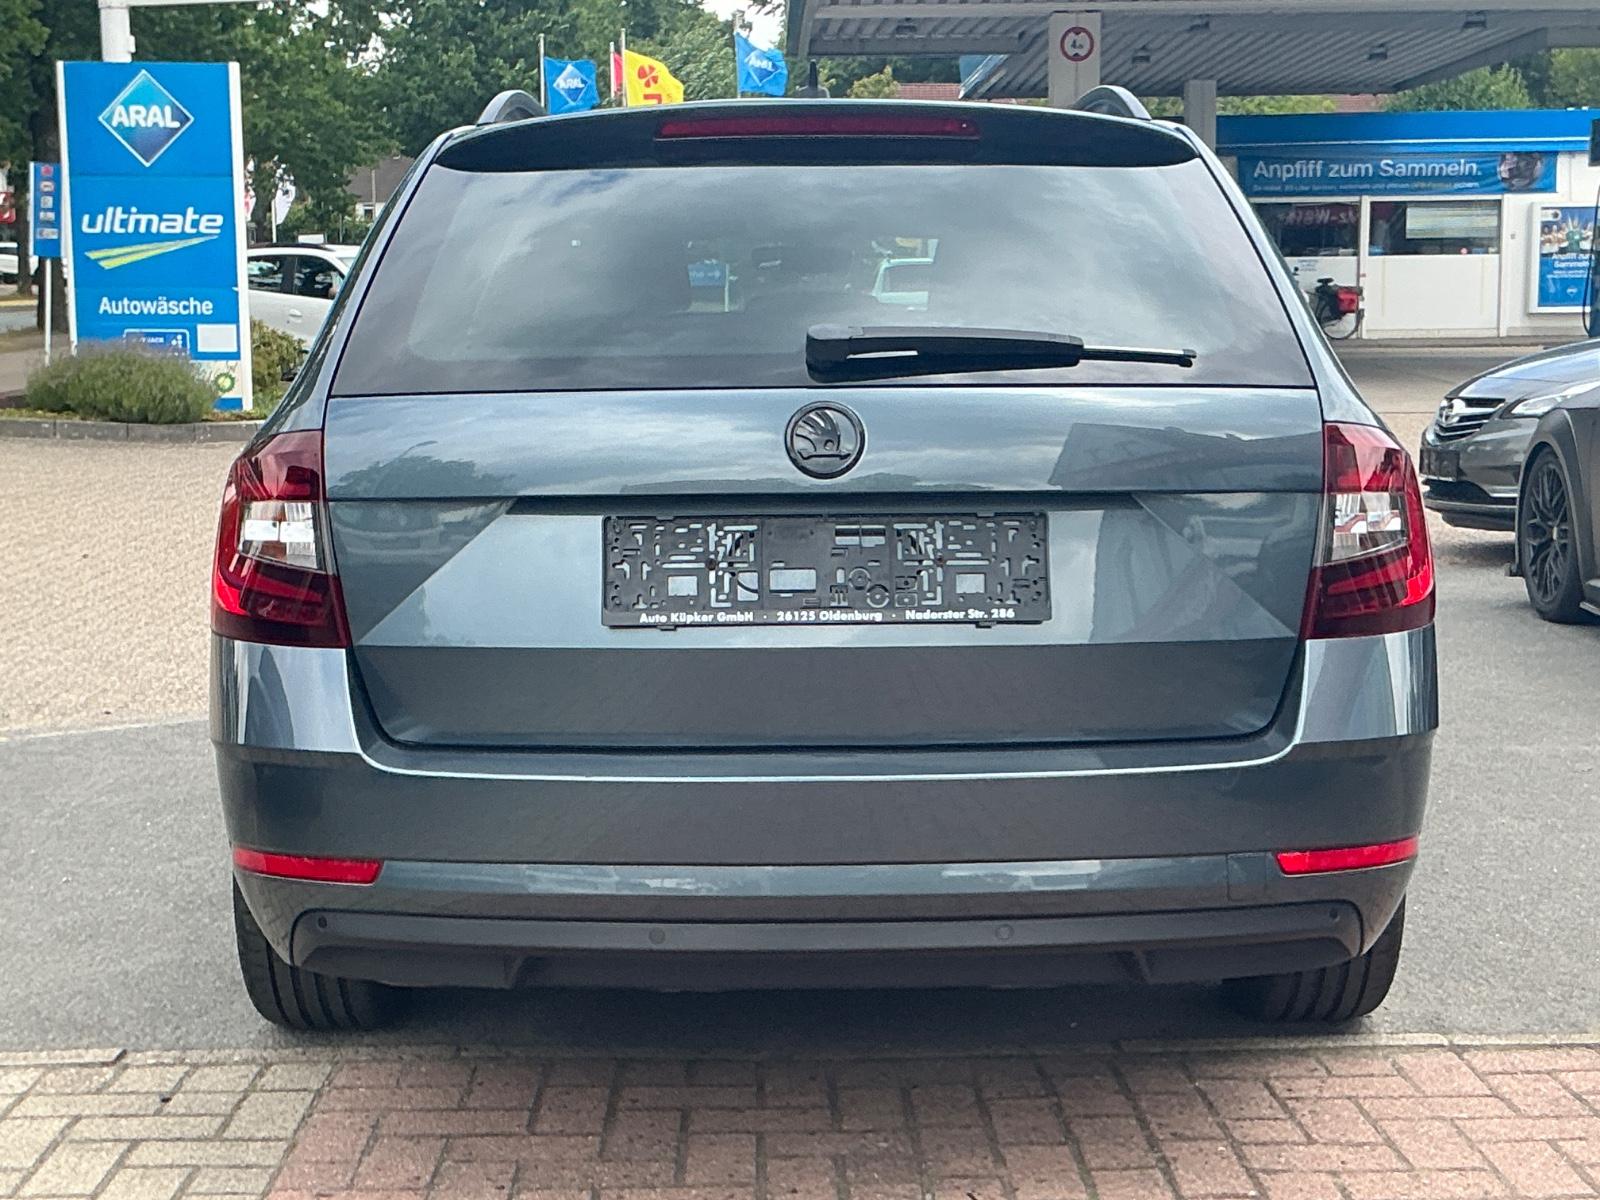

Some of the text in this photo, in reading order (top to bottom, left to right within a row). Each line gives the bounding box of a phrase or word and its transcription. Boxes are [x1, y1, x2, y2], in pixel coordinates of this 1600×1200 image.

[558, 77, 585, 89] ARAL
[111, 104, 181, 128] ARAL
[1253, 158, 1482, 182] Anpfiff zum Sammeln.
[81, 206, 224, 234] ultimate
[98, 296, 214, 316] Autowäsche
[639, 608, 1015, 624] Auto Küpker GmbH 26125 Oldenburg Nadorster Str. 286
